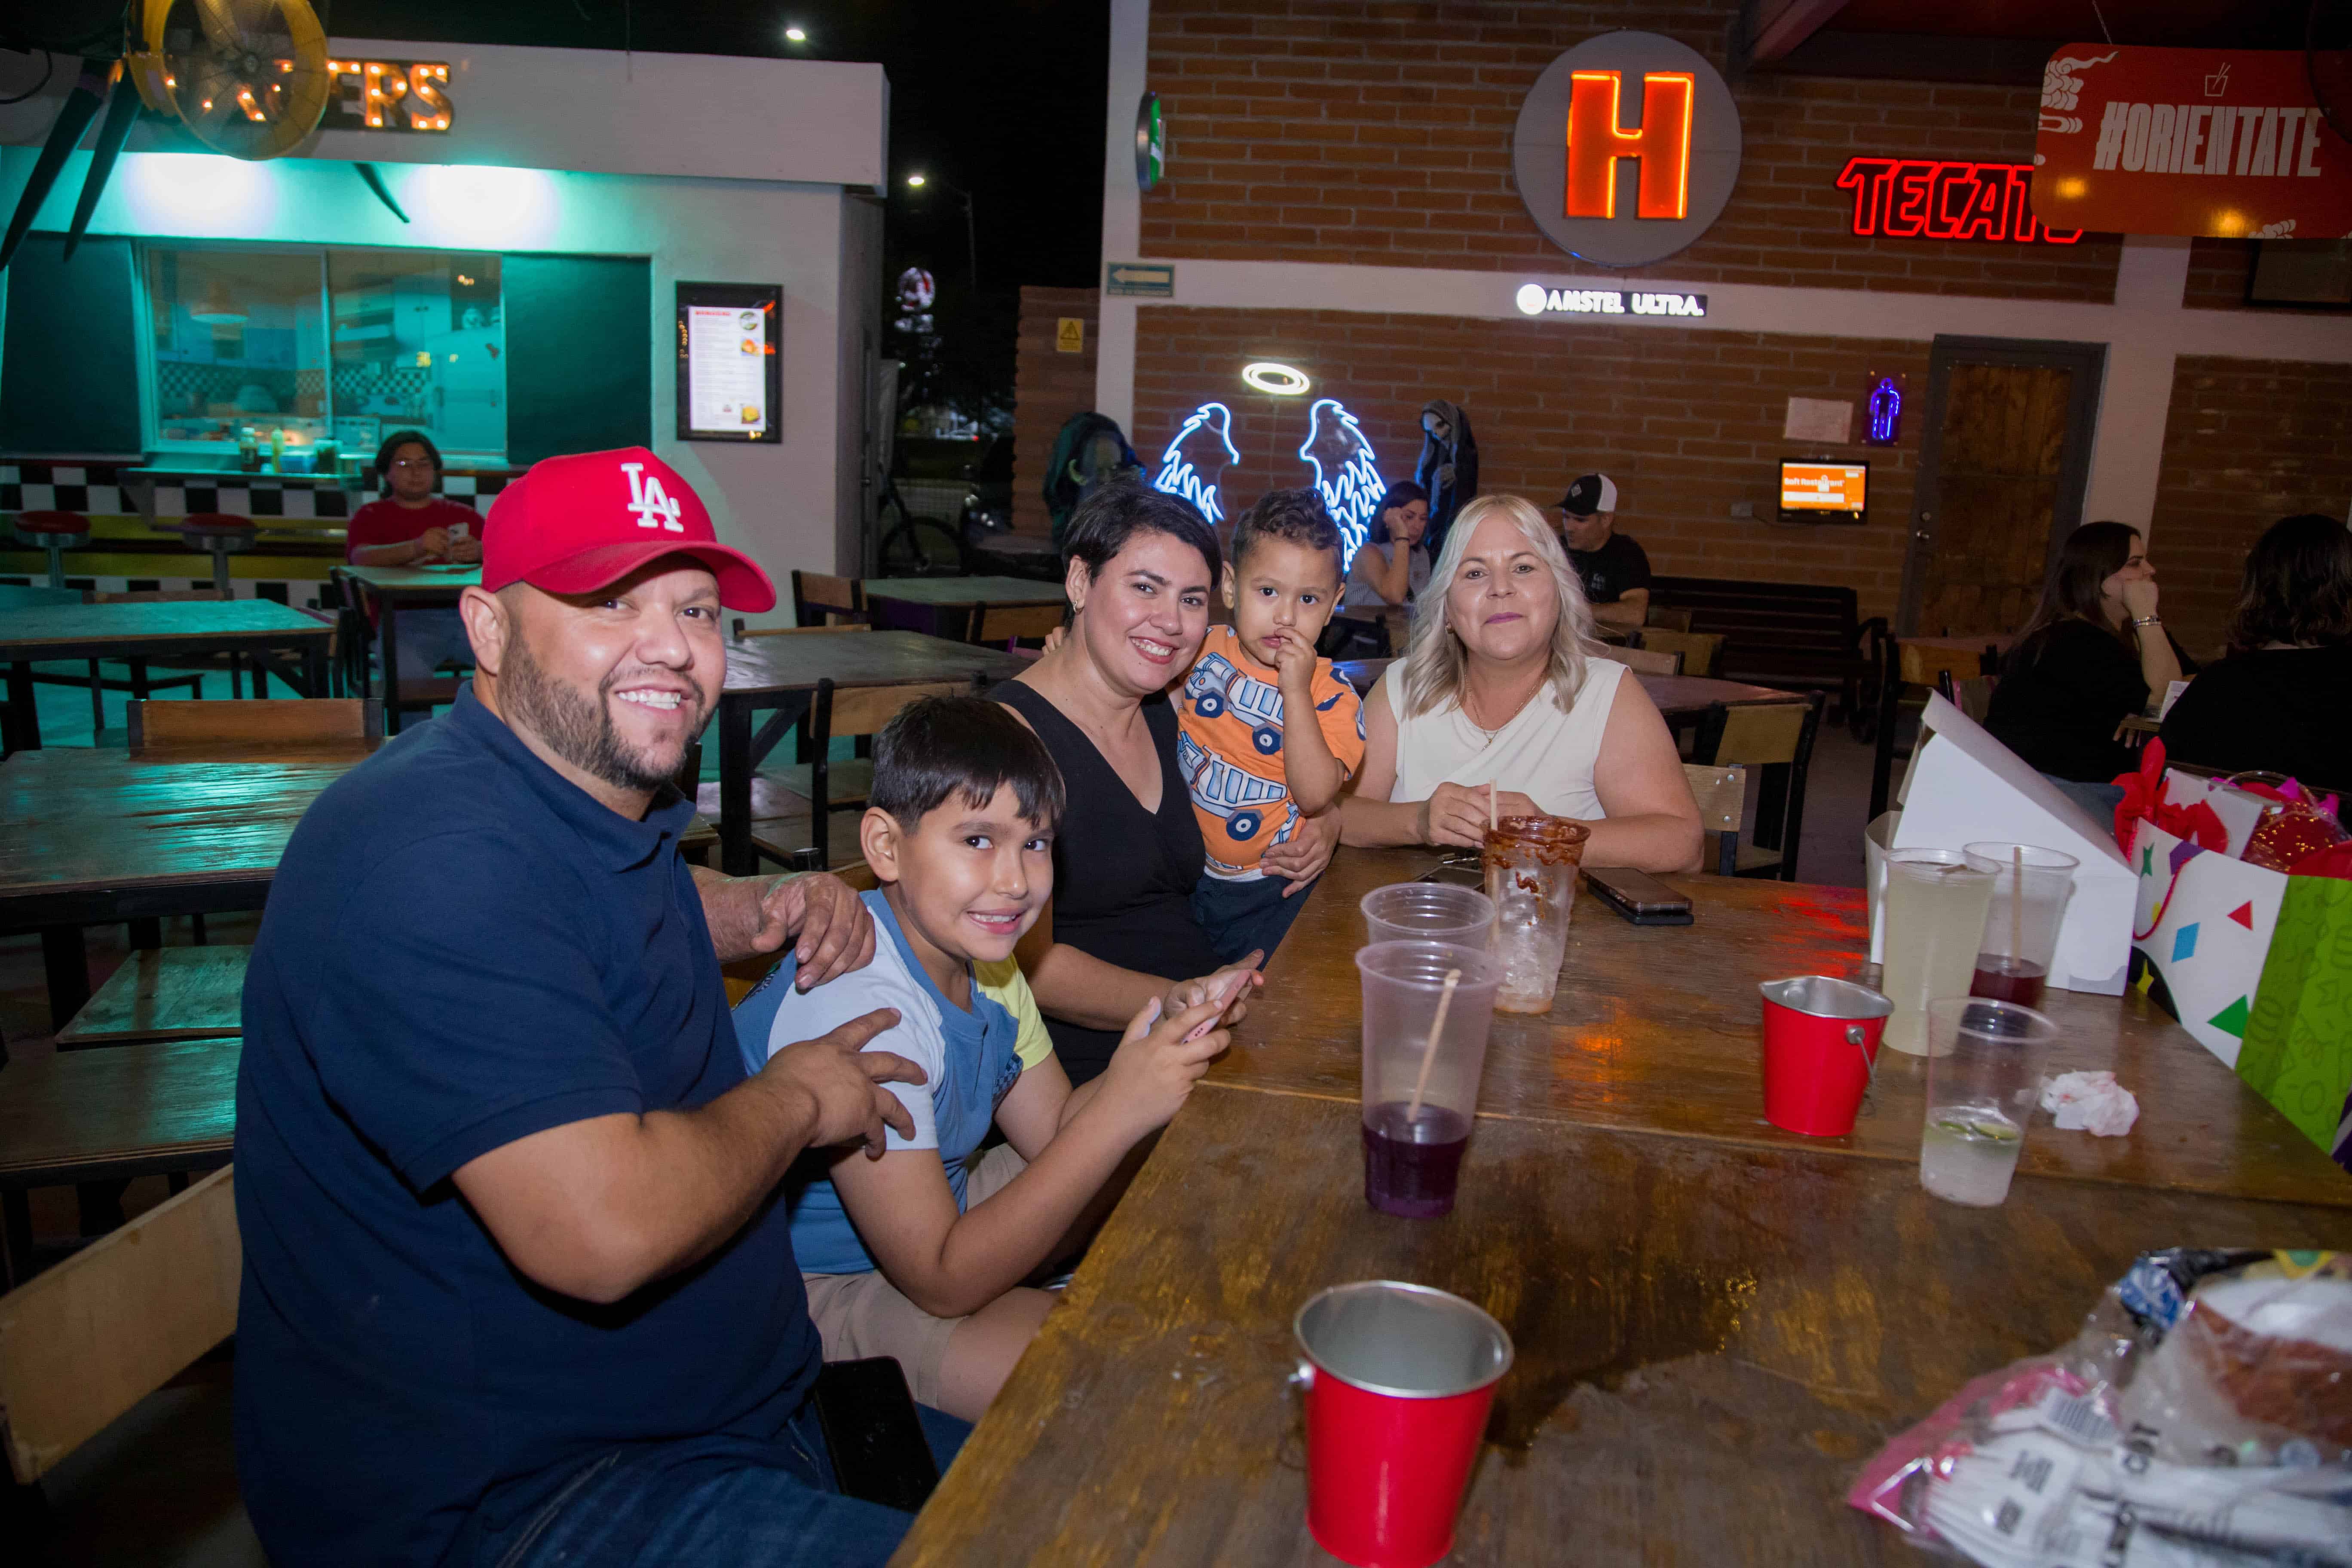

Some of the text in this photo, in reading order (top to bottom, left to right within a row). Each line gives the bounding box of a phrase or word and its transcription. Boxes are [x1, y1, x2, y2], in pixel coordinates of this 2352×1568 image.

[1566, 70, 1694, 218] H
[2092, 101, 2324, 177] #ORIENTATE
[1837, 157, 2082, 243] TECAT
[1547, 290, 1625, 313] AMSTEL
[621, 463, 684, 533] LA
